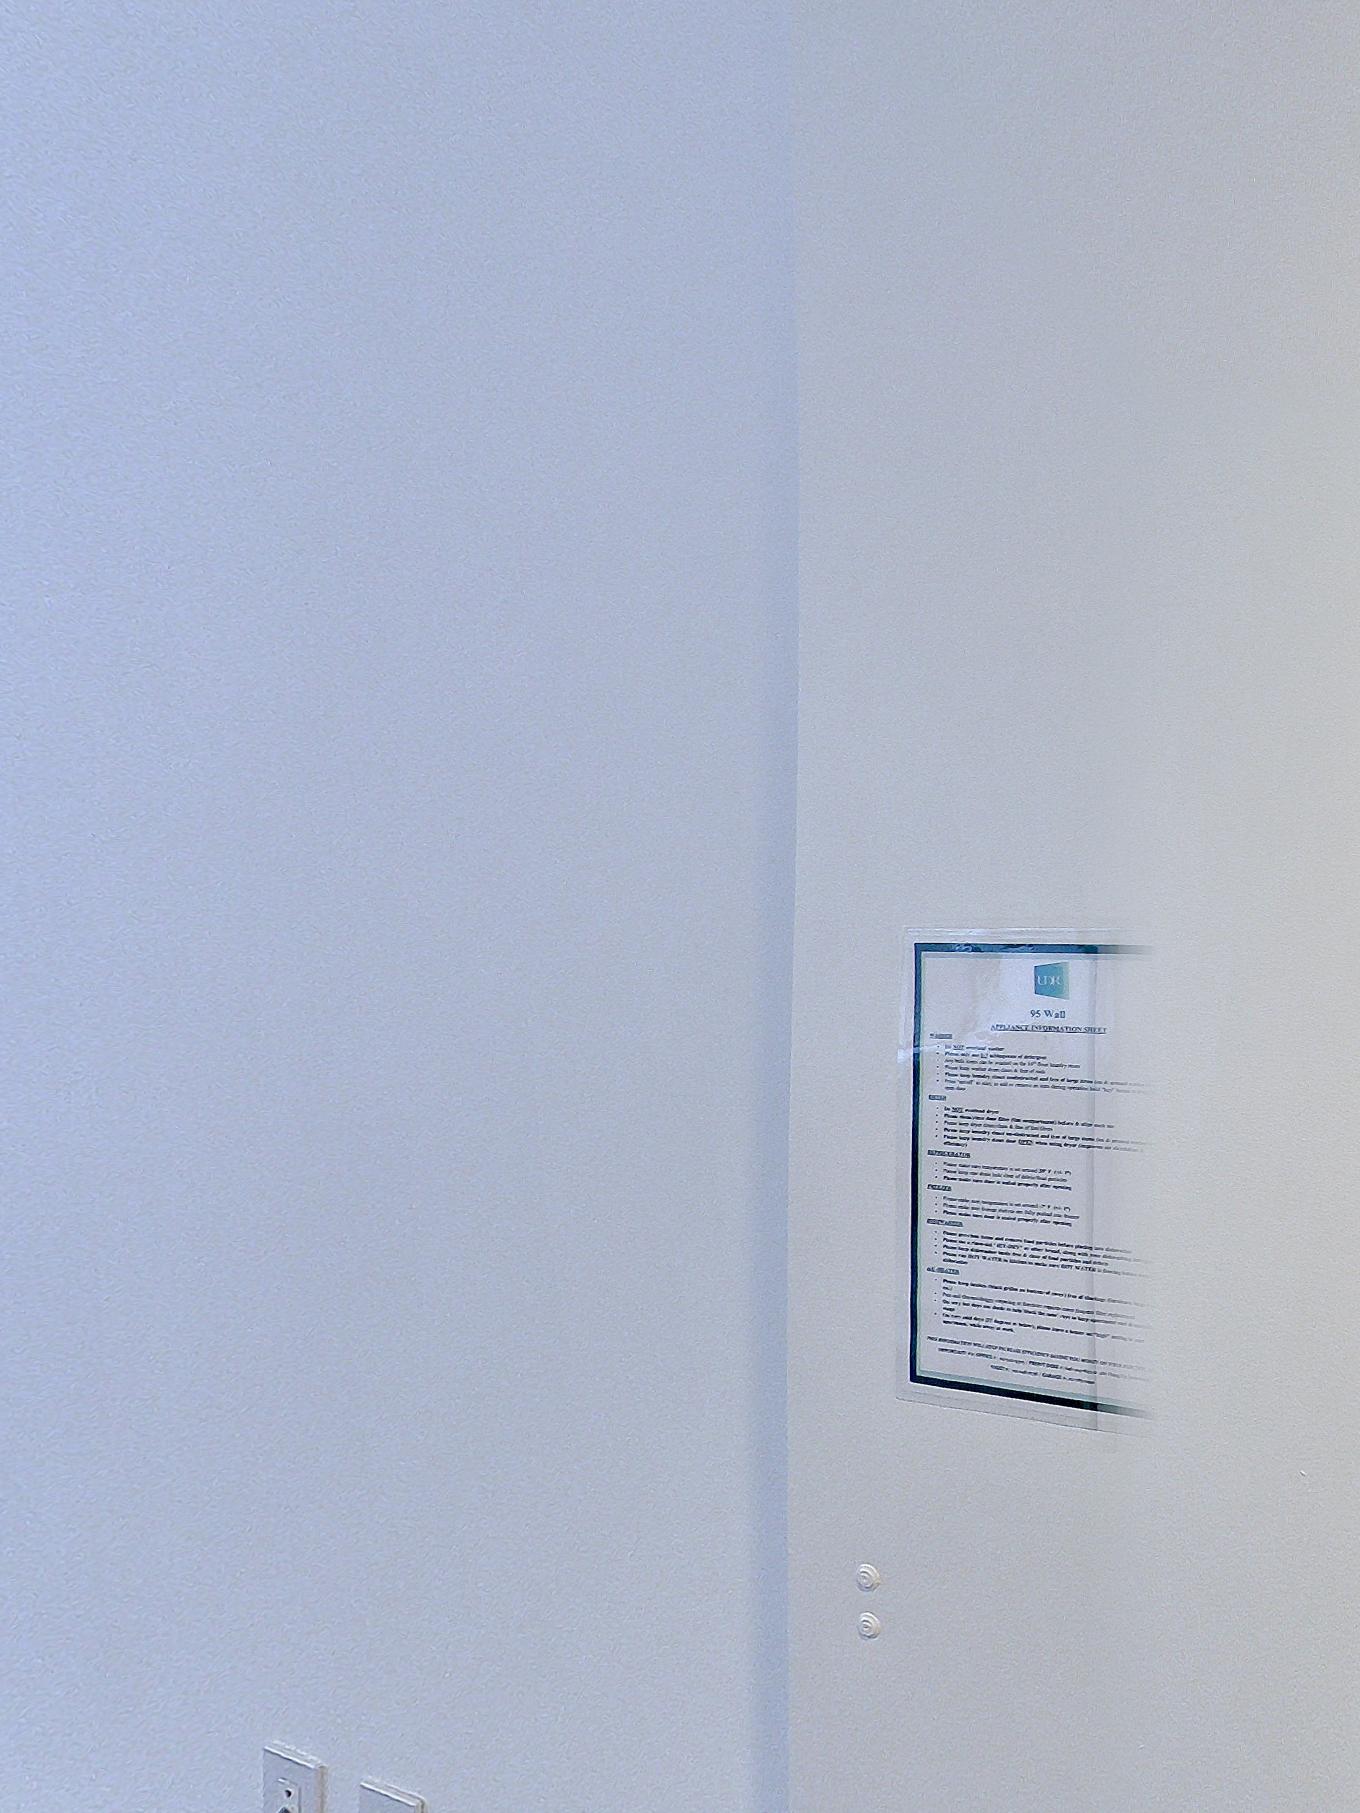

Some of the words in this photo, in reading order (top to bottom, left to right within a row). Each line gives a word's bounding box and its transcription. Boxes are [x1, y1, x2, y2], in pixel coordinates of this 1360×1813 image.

[1030, 1010, 1041, 1018] 95
[1044, 1010, 1066, 1019] Wall
[990, 1024, 1030, 1032] APPLIANCE
[1030, 1025, 1082, 1034] INFORMATION
[1084, 1026, 1107, 1034] SHEET
